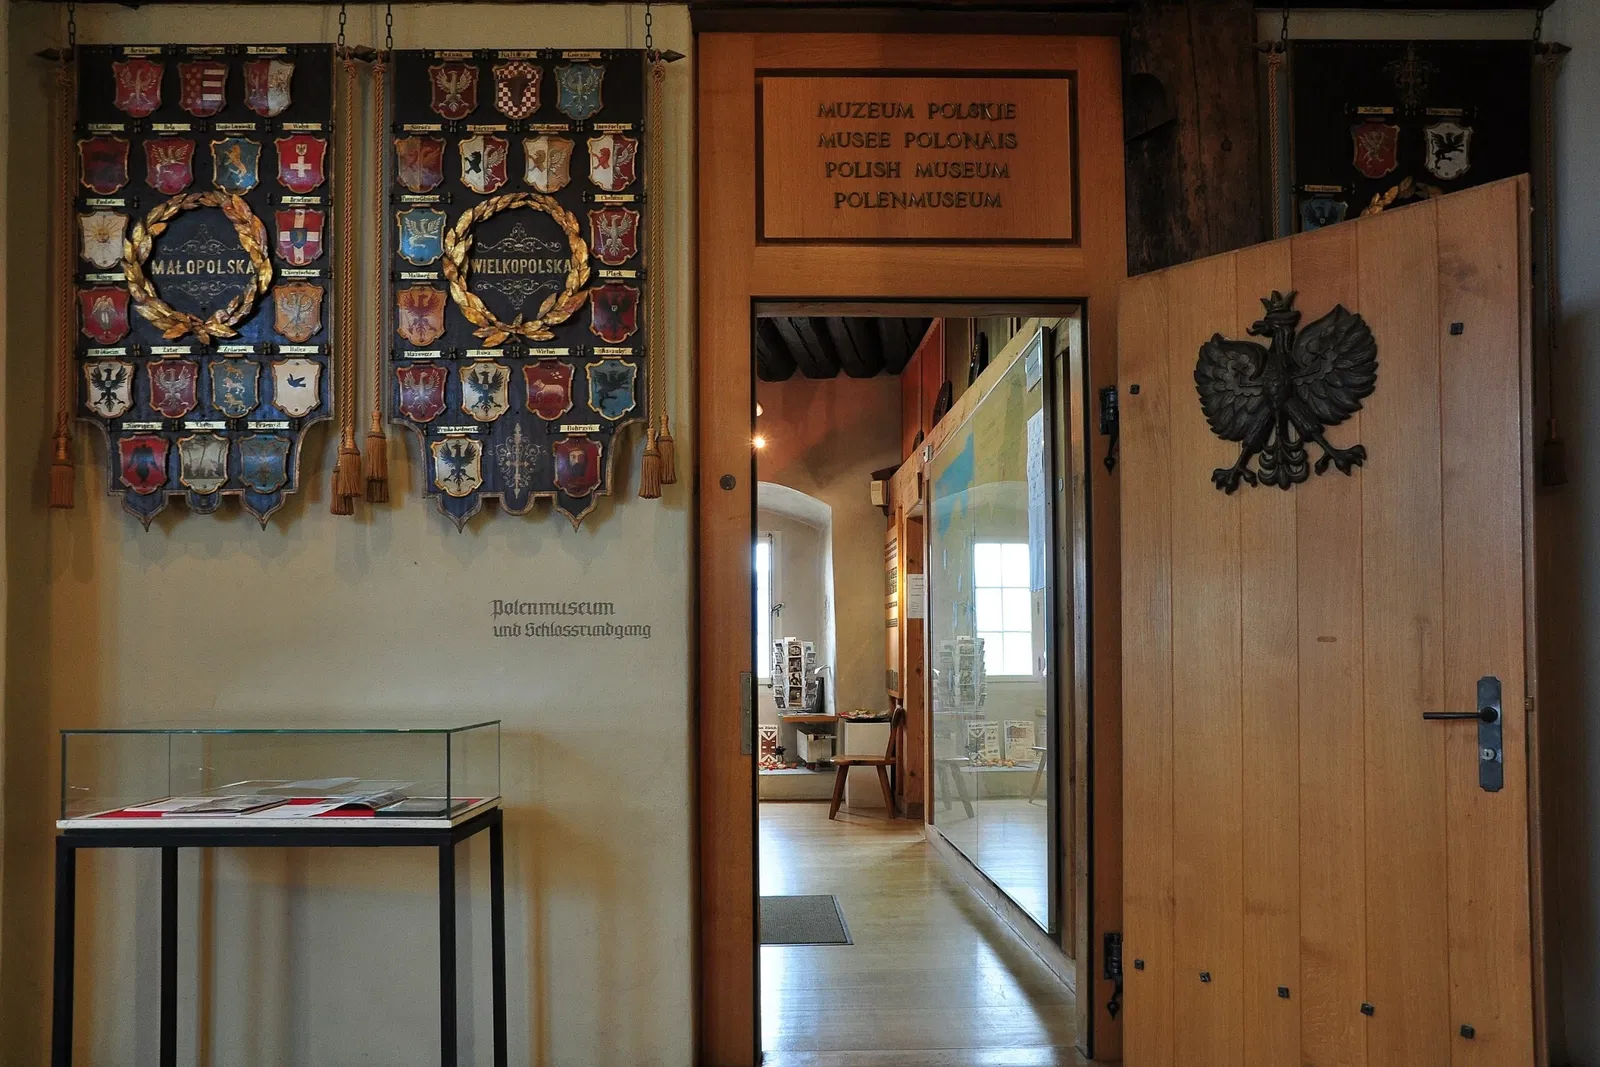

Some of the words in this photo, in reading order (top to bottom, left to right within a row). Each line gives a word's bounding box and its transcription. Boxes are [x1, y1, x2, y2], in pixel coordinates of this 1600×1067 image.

[816, 102, 914, 119] MUZEUM
[927, 102, 1017, 121] POLSKIE
[817, 131, 891, 148] MUSEE
[904, 131, 1018, 150] POLONAIS
[825, 161, 901, 178] POLISH
[914, 161, 1010, 178] MUSEUM
[834, 191, 1003, 209] POLENMUSEUM
[151, 260, 255, 275] MAŁOPOLSKA
[470, 259, 573, 274] WIELKOPOLSKA
[489, 599, 616, 621] Polenmuseum
[492, 622, 521, 637] und
[525, 622, 651, 640] Schlossrundgang
